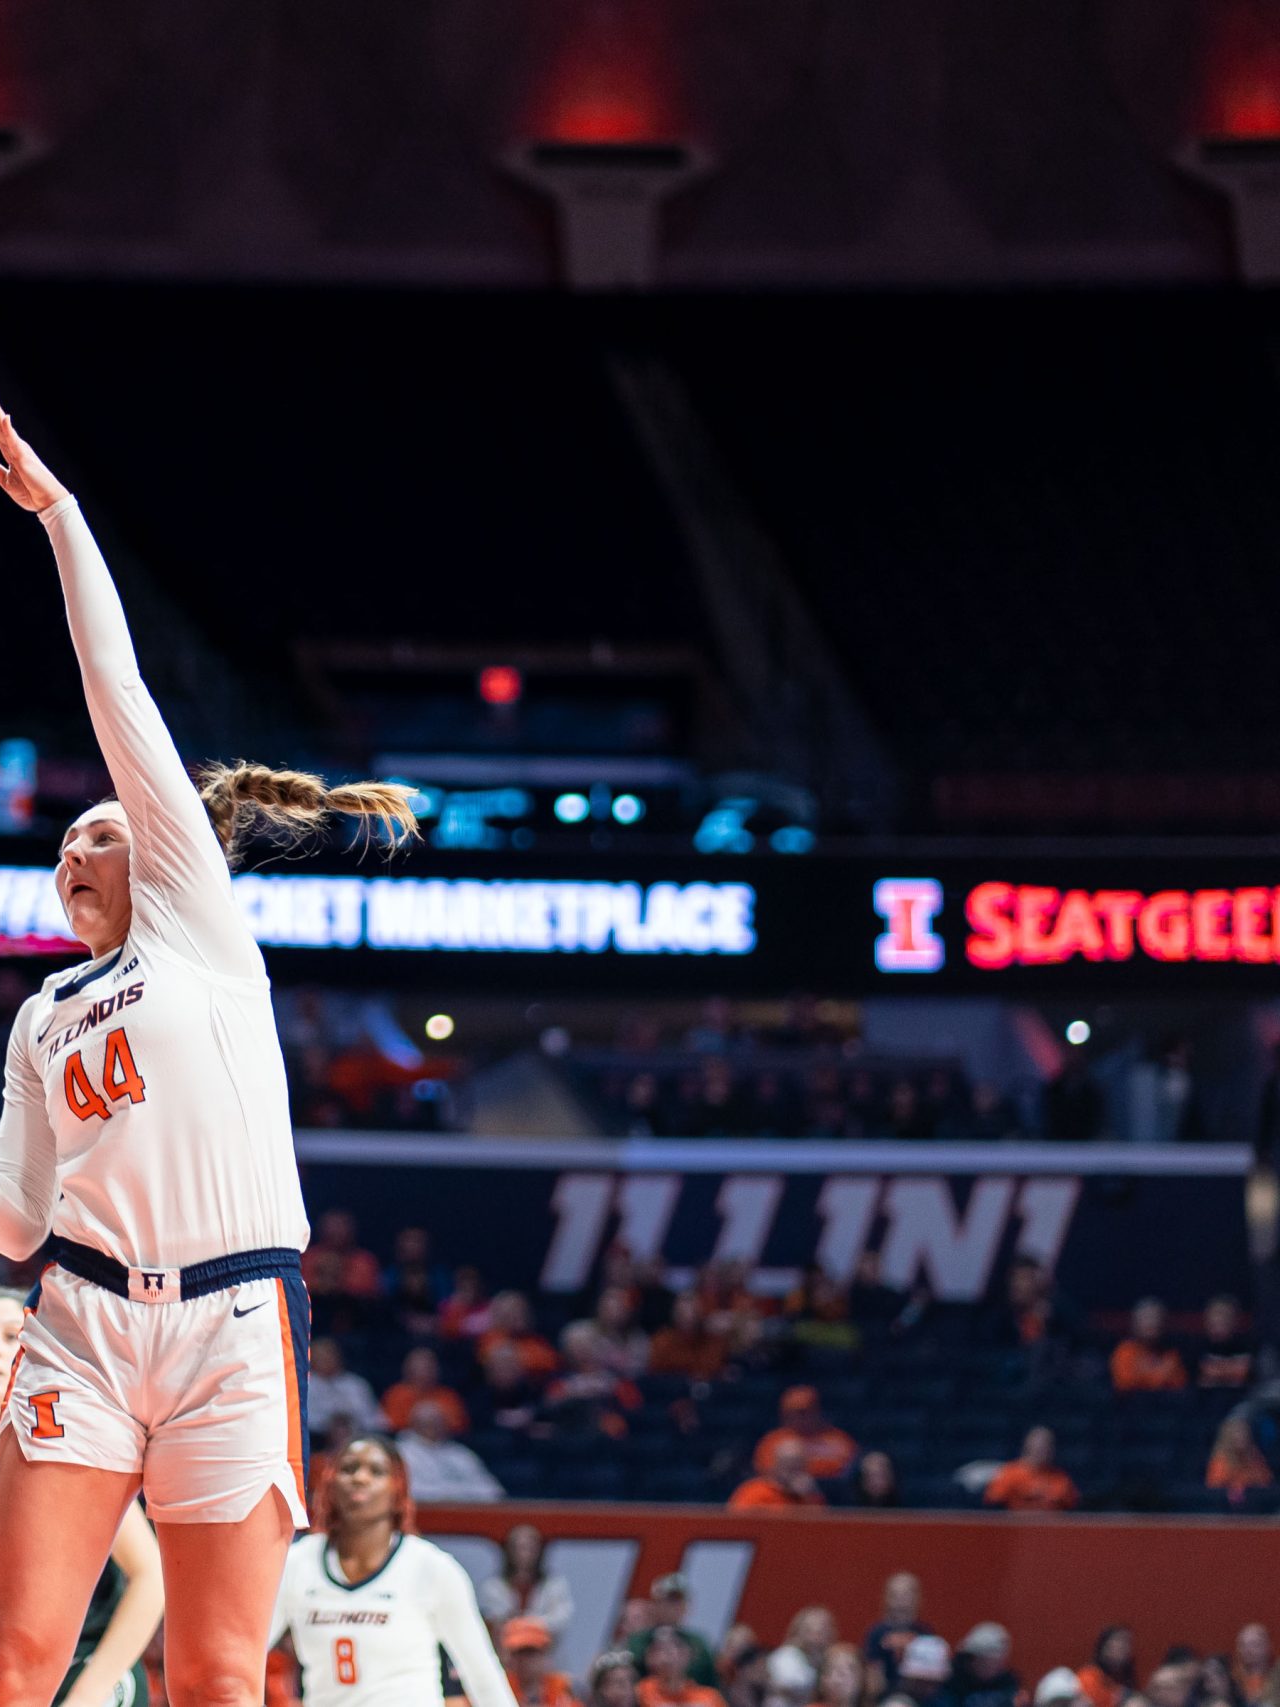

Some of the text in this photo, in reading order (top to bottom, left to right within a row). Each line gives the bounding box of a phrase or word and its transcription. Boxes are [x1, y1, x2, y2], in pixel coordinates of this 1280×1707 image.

[366, 877, 757, 955] MARKETPLACE
[966, 880, 1280, 971] SEATGEE
[48, 981, 144, 1064] ILLINOIS
[64, 1027, 147, 1122] 44
[540, 1174, 1082, 1301] ILLINI
[334, 1637, 357, 1684] 8
